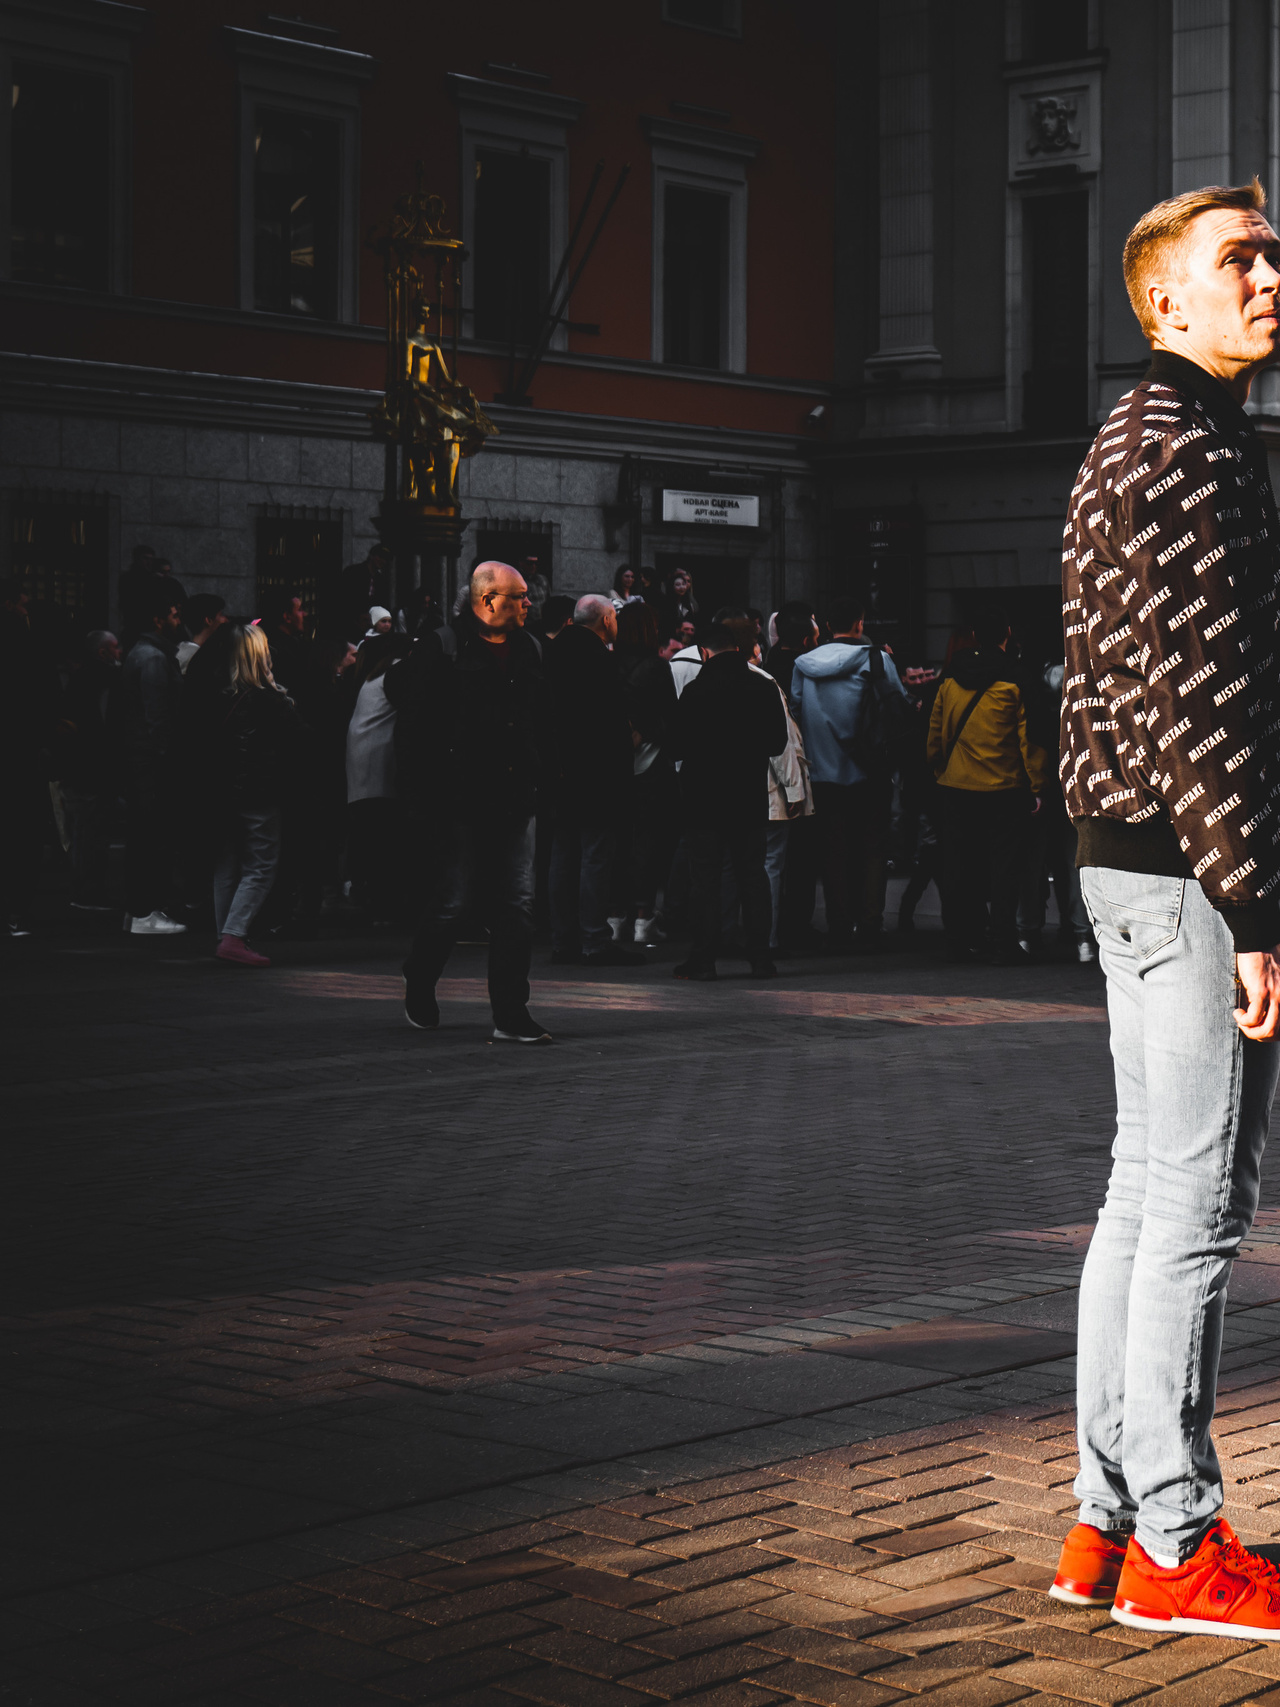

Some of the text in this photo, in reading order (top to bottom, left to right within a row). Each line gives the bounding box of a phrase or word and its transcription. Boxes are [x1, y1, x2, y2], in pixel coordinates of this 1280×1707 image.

[1114, 462, 1151, 497] MISTAKE
[1145, 468, 1185, 502] MISTAKE
[1180, 480, 1219, 512] MISTAKE
[711, 499, 740, 509] СЦЕНА
[1123, 521, 1160, 559] MISTAKE
[1156, 531, 1197, 567] MISTAKE
[1137, 585, 1172, 623] MISTAKE
[1167, 595, 1208, 632] MISTAKE
[1099, 624, 1132, 655] MISTAKE
[1203, 607, 1241, 641] MISTAKE
[1096, 673, 1116, 693] TAKE
[1148, 651, 1184, 687] MISTAKE
[1178, 660, 1218, 698] MISTAKE
[1072, 698, 1107, 714] MISTAK
[1109, 685, 1142, 716] MISTAKE
[1213, 673, 1251, 707] MISTAKE
[1157, 716, 1193, 753] MISTAKE
[1187, 726, 1228, 764] MISTAKE
[1101, 788, 1136, 811] MISTAKE
[1174, 782, 1206, 817] MISTAKE
[1204, 792, 1241, 829] MISTAKE
[1193, 847, 1222, 879] MISTAKE
[1220, 857, 1258, 893] MISTAKE
